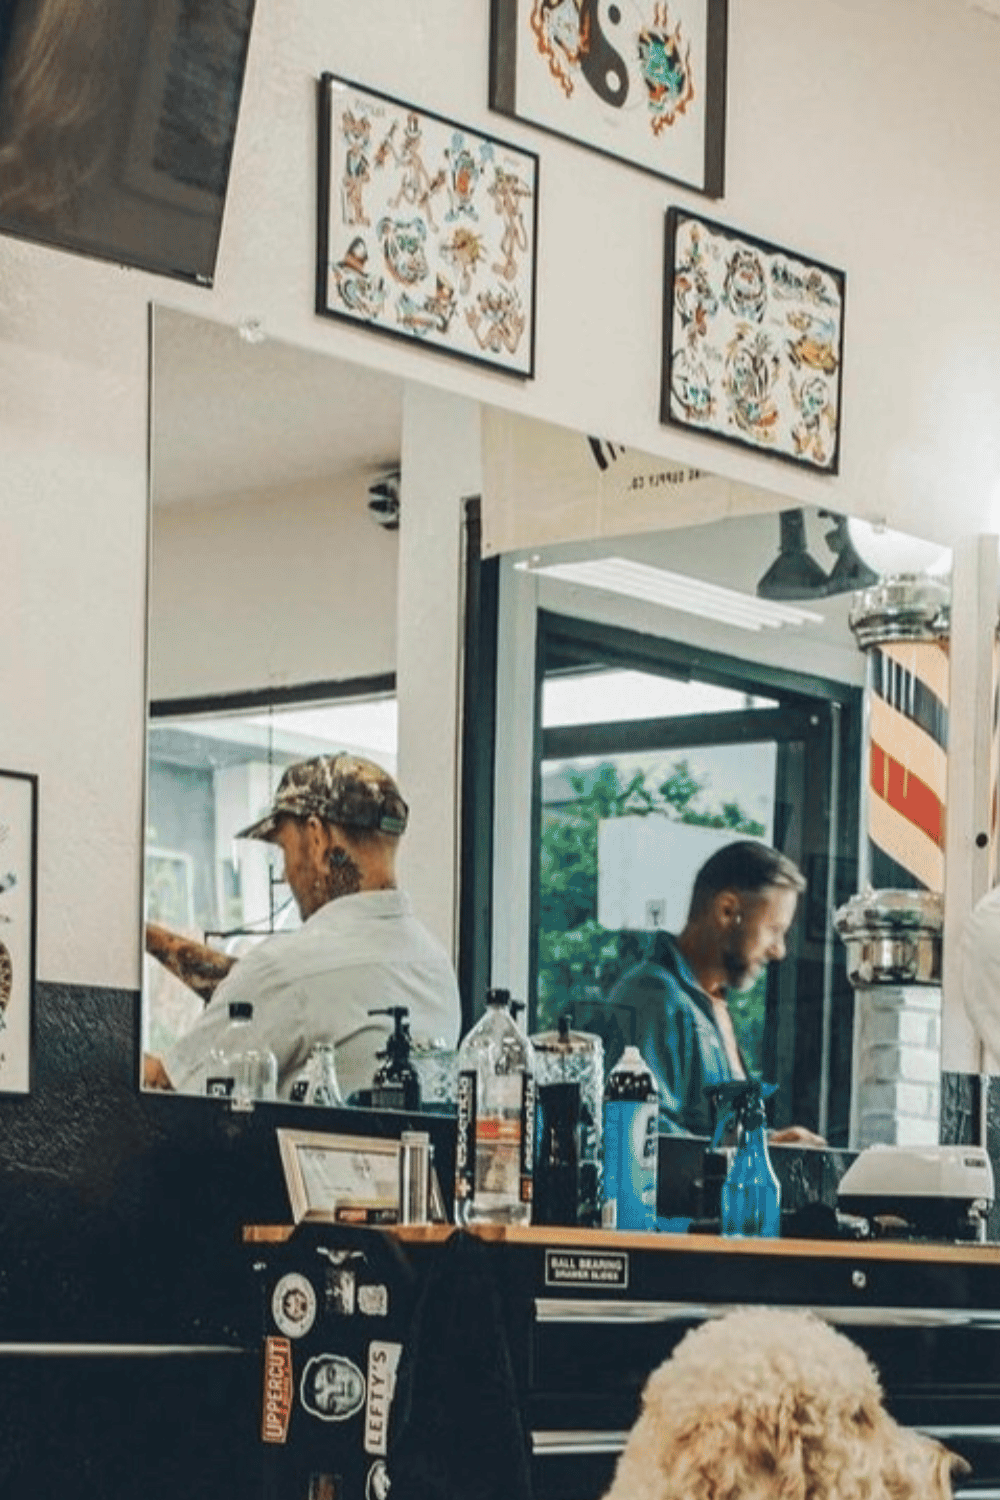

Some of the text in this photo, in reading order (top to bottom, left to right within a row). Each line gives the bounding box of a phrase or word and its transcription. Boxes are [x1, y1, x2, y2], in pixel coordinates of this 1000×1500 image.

[551, 1256, 575, 1269] BALL
[266, 1341, 289, 1437] UPPERCUT
[368, 1350, 387, 1446] LEFTY'S
